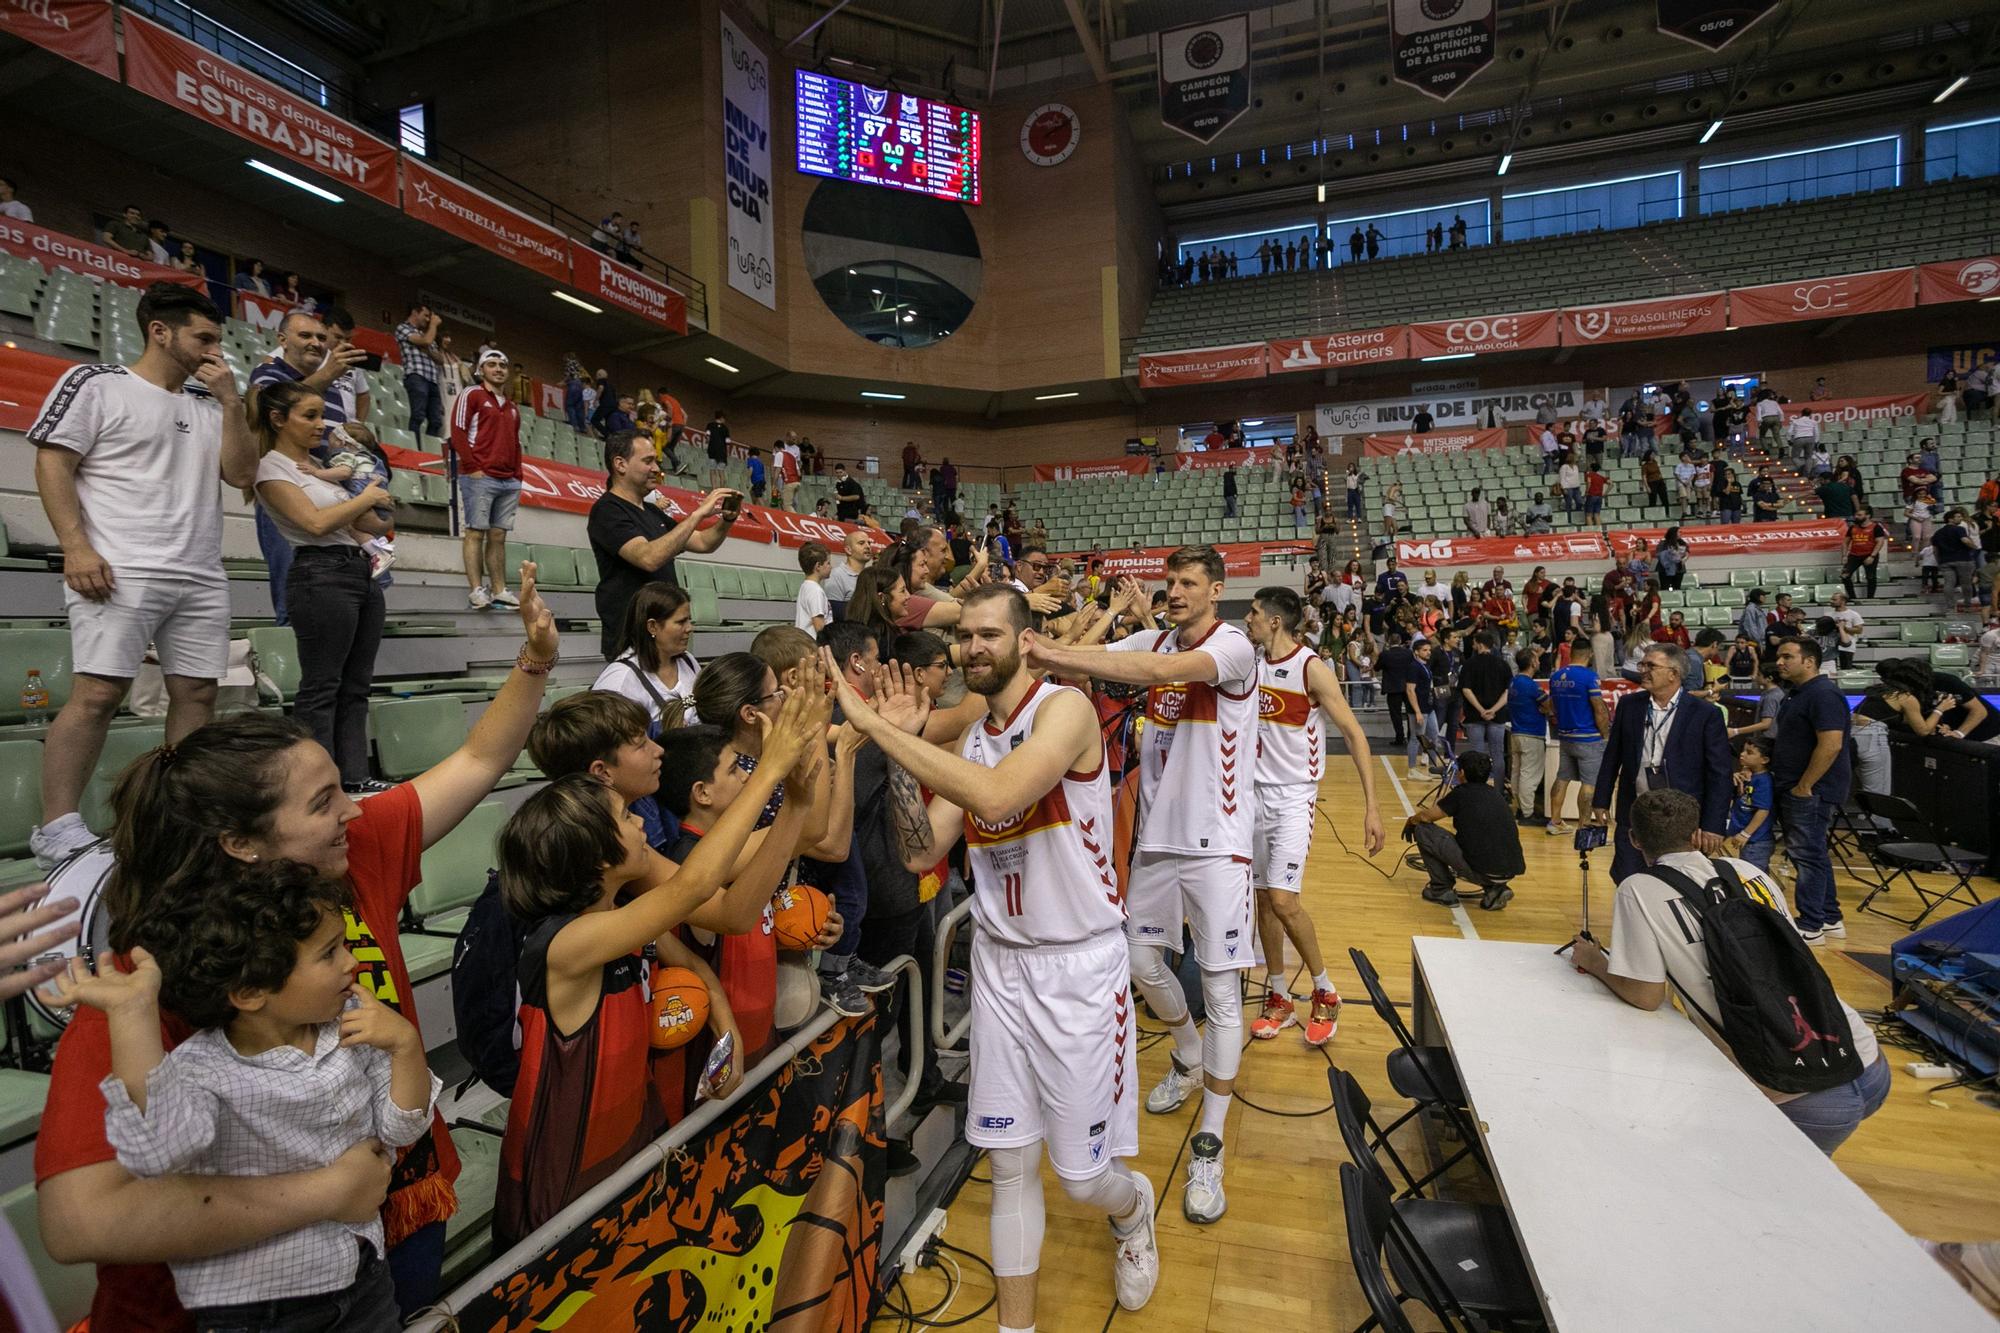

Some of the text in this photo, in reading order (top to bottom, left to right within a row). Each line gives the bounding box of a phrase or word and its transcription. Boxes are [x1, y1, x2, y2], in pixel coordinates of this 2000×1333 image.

[1700, 18, 1734, 32] 05/06
[1415, 26, 1472, 44] CAMPEÓN
[1400, 33, 1489, 58] COPA PRÍNCIPE
[1406, 45, 1482, 67] DE ASTURIAS
[1180, 75, 1231, 92] CAMPEÓN
[1431, 72, 1456, 83] 2006
[196, 58, 355, 149] Clínicas dentales
[1182, 86, 1229, 102] LIGA BSR
[725, 97, 767, 152] MUY
[863, 120, 887, 138] 67
[900, 127, 922, 146] 55
[726, 122, 750, 163] DE
[882, 141, 905, 157] 0.0
[727, 152, 770, 205] MUR
[728, 180, 761, 225] CIA
[438, 196, 507, 238] ESTRELLA
[516, 232, 565, 264] LEVANTE
[32, 234, 142, 280] dentales
[600, 259, 668, 308] Prevemur
[600, 284, 642, 310] Prevención
[648, 305, 667, 321] Salud
[1614, 307, 1712, 326] V2 GASOLINERAS
[1327, 331, 1384, 349] Asterra
[1446, 340, 1519, 354] OFTALMOLOGÍA
[1327, 345, 1393, 364] Partners
[1160, 362, 1208, 374] ESTRELLA
[1216, 357, 1261, 369] LEVANTE
[1436, 401, 1465, 418] DE
[1789, 403, 1916, 424] sperDumbo
[1423, 435, 1474, 447] MITSUBISHI
[1075, 464, 1120, 473] Construcciones
[1754, 528, 1840, 540] LEVANTE
[1103, 556, 1165, 569] Impulsa
[1112, 567, 1164, 576] marca
[1004, 871, 1024, 918] 11
[658, 1008, 694, 1028] UCAM
[1794, 1046, 1847, 1068] AIR
[985, 1117, 1015, 1129] ESP
